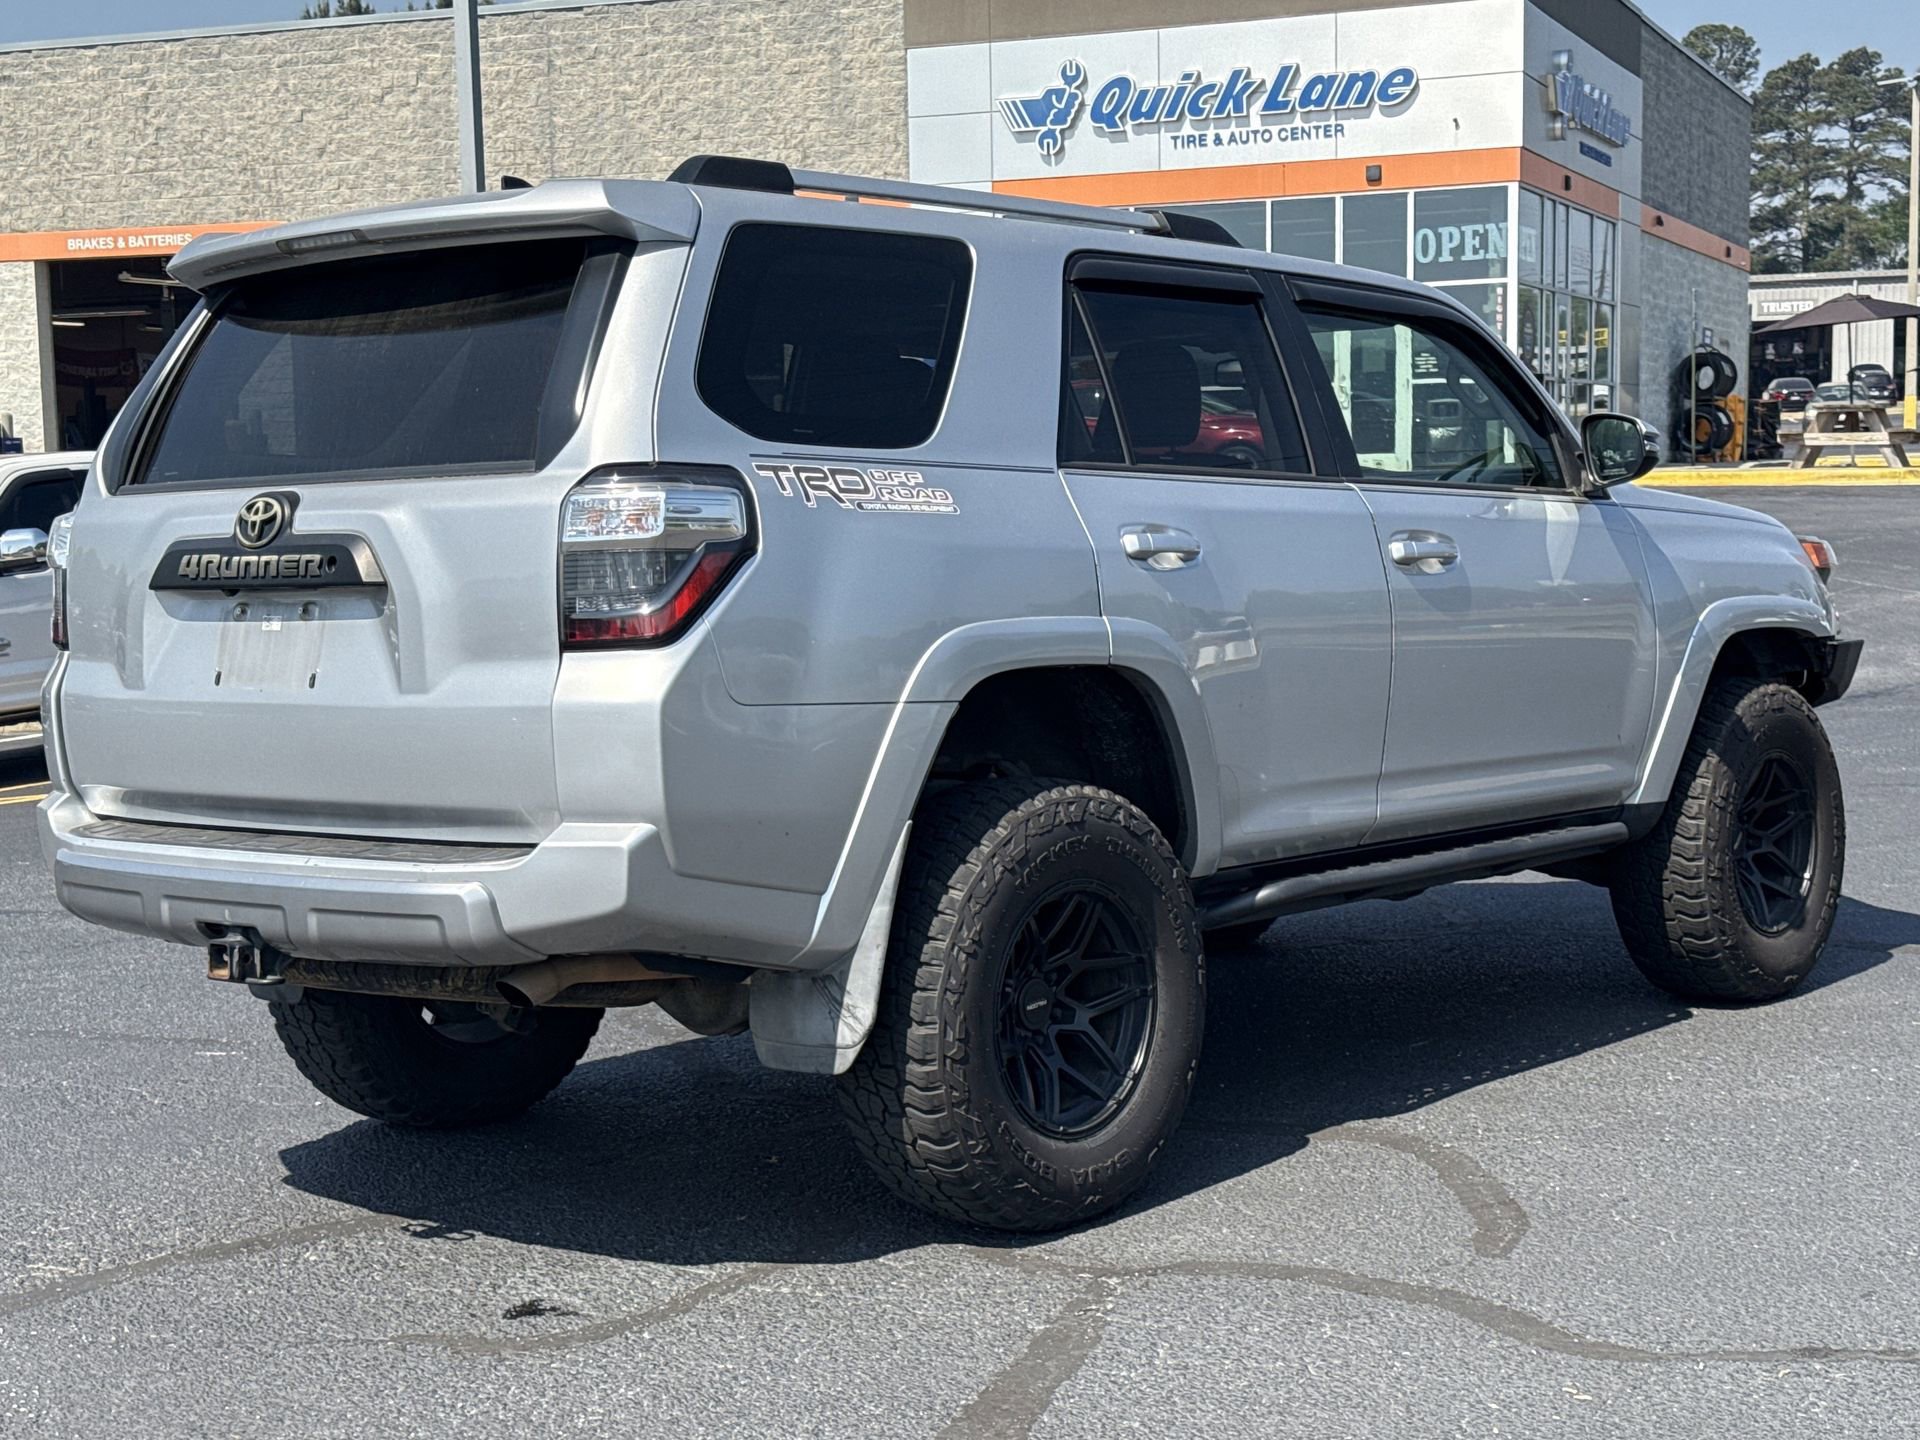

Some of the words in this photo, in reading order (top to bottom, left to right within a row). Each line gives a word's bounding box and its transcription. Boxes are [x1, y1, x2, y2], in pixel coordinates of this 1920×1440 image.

[1090, 67, 1264, 132] Quick
[1258, 62, 1418, 116] Lane
[1170, 134, 1208, 150] TIRE
[1212, 132, 1224, 146] &
[1227, 129, 1275, 146] AUTO
[1279, 124, 1345, 142] CENTER
[67, 237, 114, 250] BRAKES
[117, 236, 126, 249] &
[128, 233, 193, 248] BATTERIES
[1415, 222, 1508, 263] OPEN
[1761, 301, 1814, 313] TRUSTED
[752, 462, 875, 508] TRD
[867, 469, 924, 485] OFF
[876, 486, 953, 503] ROAD
